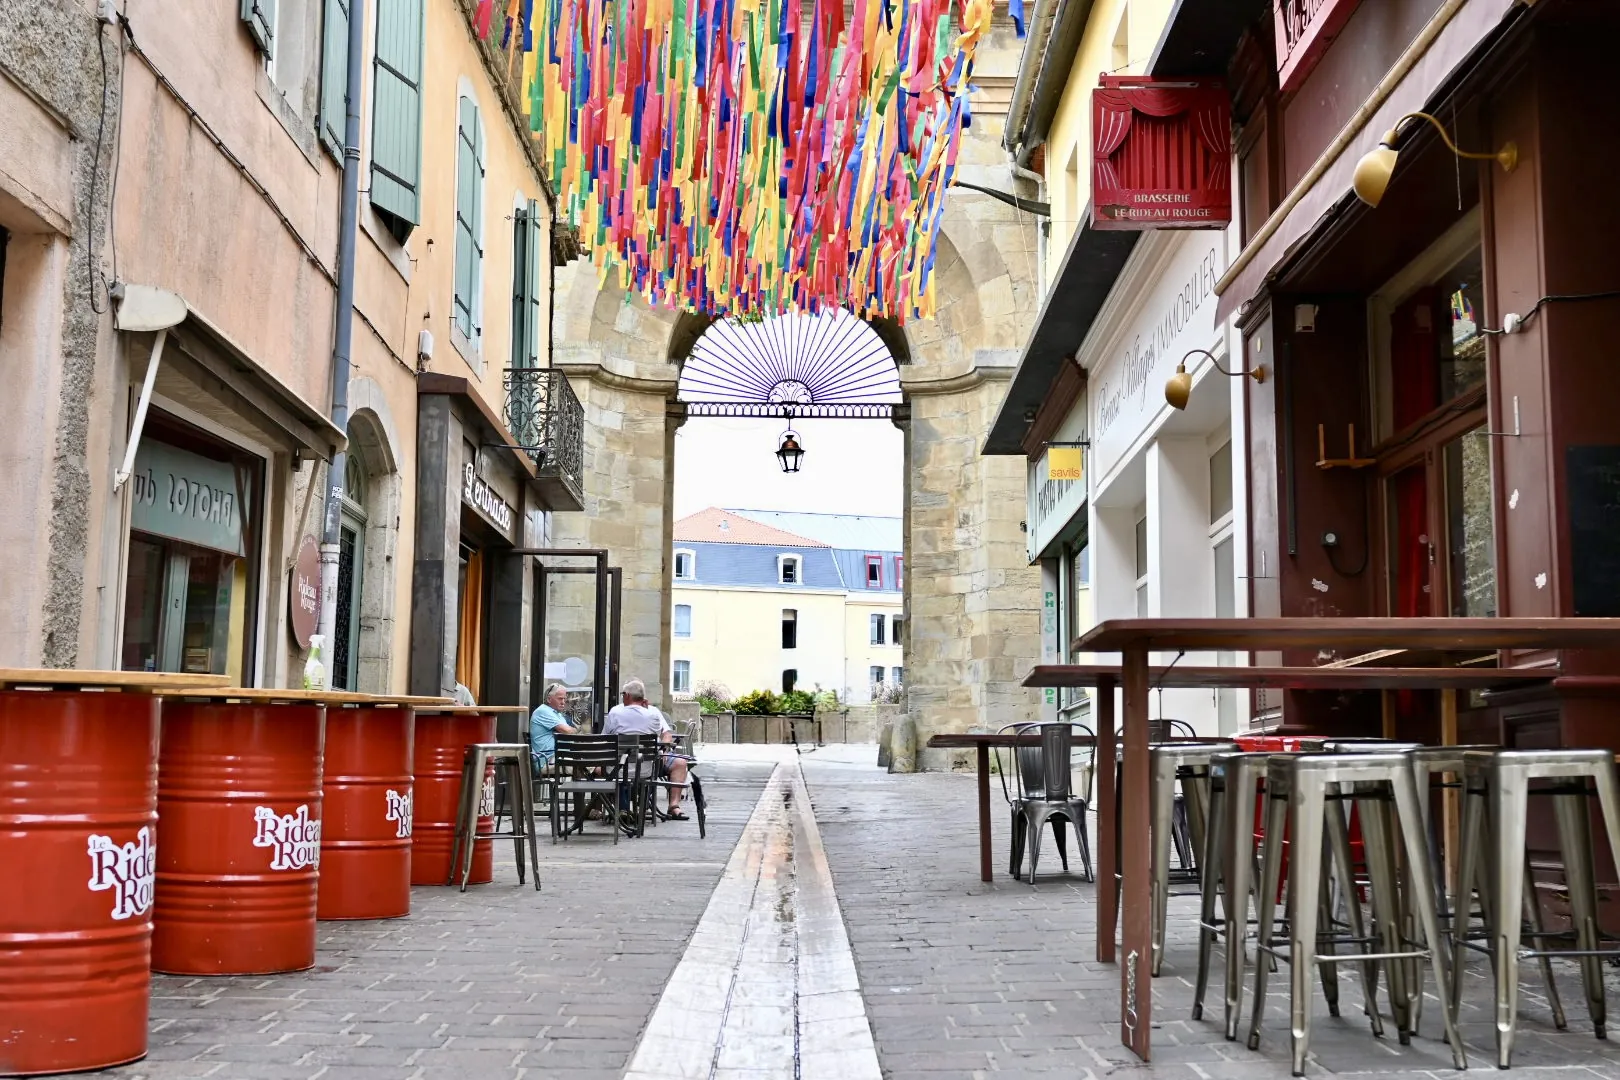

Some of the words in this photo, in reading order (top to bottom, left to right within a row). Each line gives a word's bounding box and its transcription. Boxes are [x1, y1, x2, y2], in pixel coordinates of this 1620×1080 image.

[1134, 193, 1190, 203] BRASSERIE
[1114, 208, 1129, 217] LE
[1129, 208, 1170, 217] RIDEAU
[1172, 208, 1211, 217] ROUGE
[1157, 247, 1217, 361] IMMOBILIER
